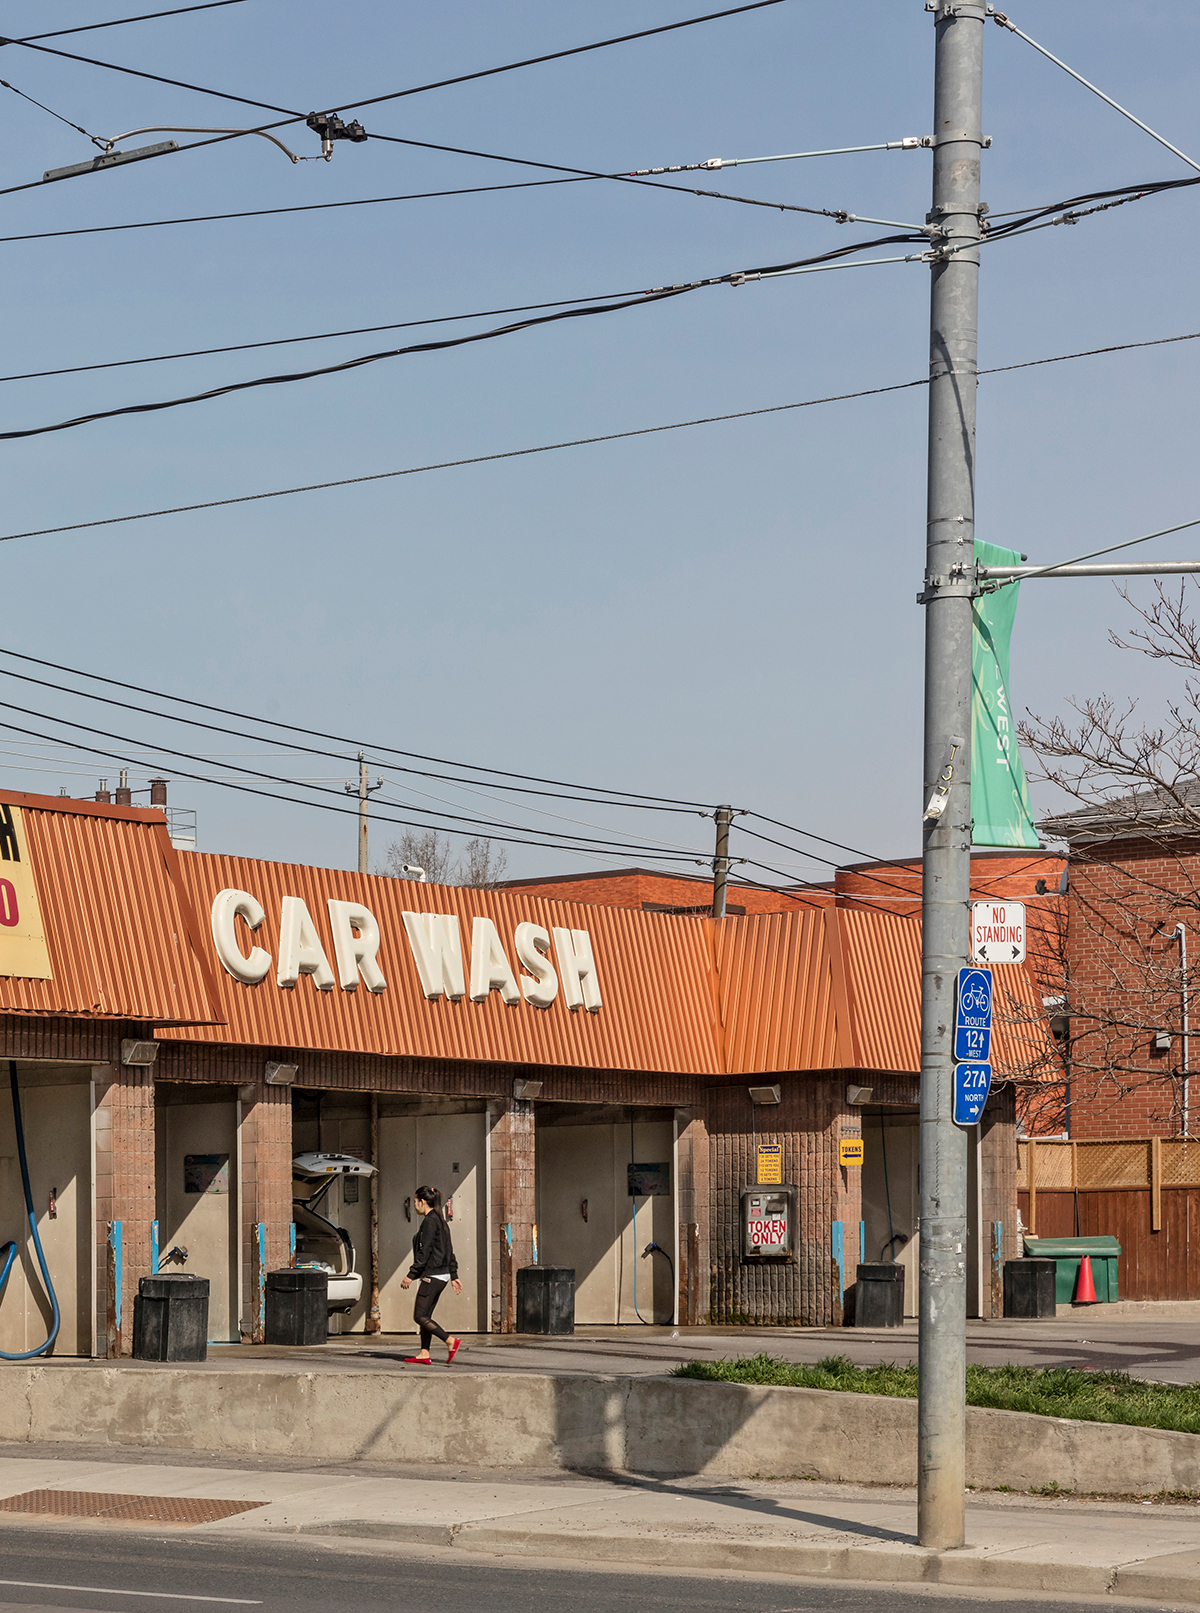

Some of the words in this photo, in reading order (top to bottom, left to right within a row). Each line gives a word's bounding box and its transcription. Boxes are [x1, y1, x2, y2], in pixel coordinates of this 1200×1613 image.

[992, 907, 1006, 924] NO
[976, 925, 1022, 944] STANDING
[211, 888, 388, 995] CAR
[401, 910, 602, 1013] WASH
[964, 1016, 986, 1027] ROUTE
[965, 1030, 979, 1048] 12
[968, 1050, 982, 1058] WEST
[962, 1070, 987, 1088] 27A
[964, 1093, 984, 1102] NORTH
[748, 1221, 786, 1233] TOKEN
[752, 1232, 783, 1245] ONLY
